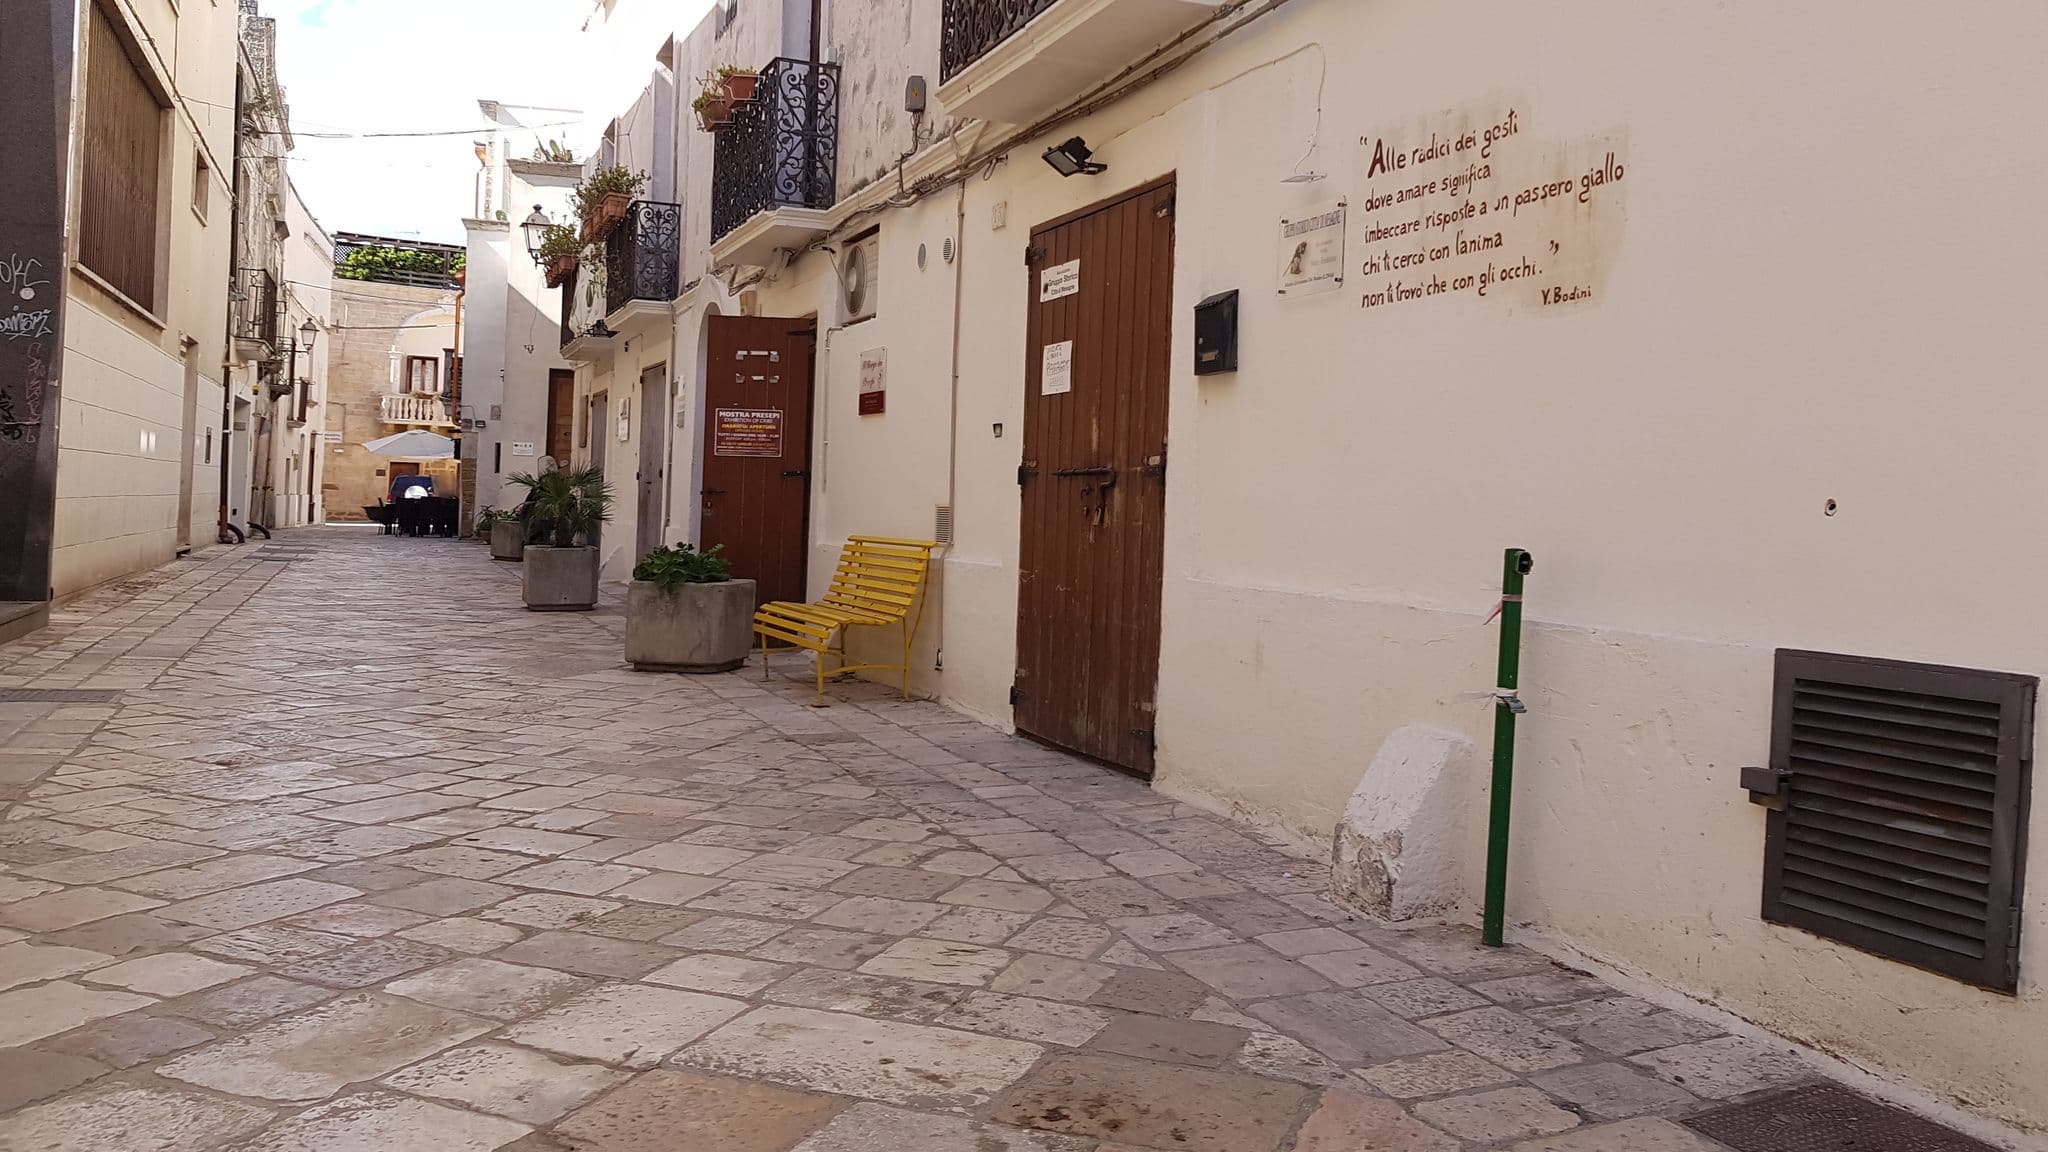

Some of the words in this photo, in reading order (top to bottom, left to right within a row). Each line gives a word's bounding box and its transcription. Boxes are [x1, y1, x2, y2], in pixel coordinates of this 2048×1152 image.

[1411, 133, 1450, 166] radici
[1455, 130, 1477, 152] dei
[1481, 108, 1518, 159] gesti
[1365, 188, 1393, 212] dove
[1396, 181, 1436, 203] amare
[1441, 163, 1491, 196] significa
[1365, 218, 1420, 244] imbeccare
[1425, 200, 1476, 232] risposte
[1479, 200, 1487, 215] a
[1515, 180, 1573, 217] passero
[1578, 152, 1624, 203] giallo
[1363, 254, 1381, 276] chi
[1383, 250, 1392, 272] ti
[1429, 244, 1449, 262] con
[1361, 292, 1385, 309] non
[1427, 274, 1447, 296] che
[1453, 273, 1474, 291] con
[1478, 262, 1495, 296] gli
